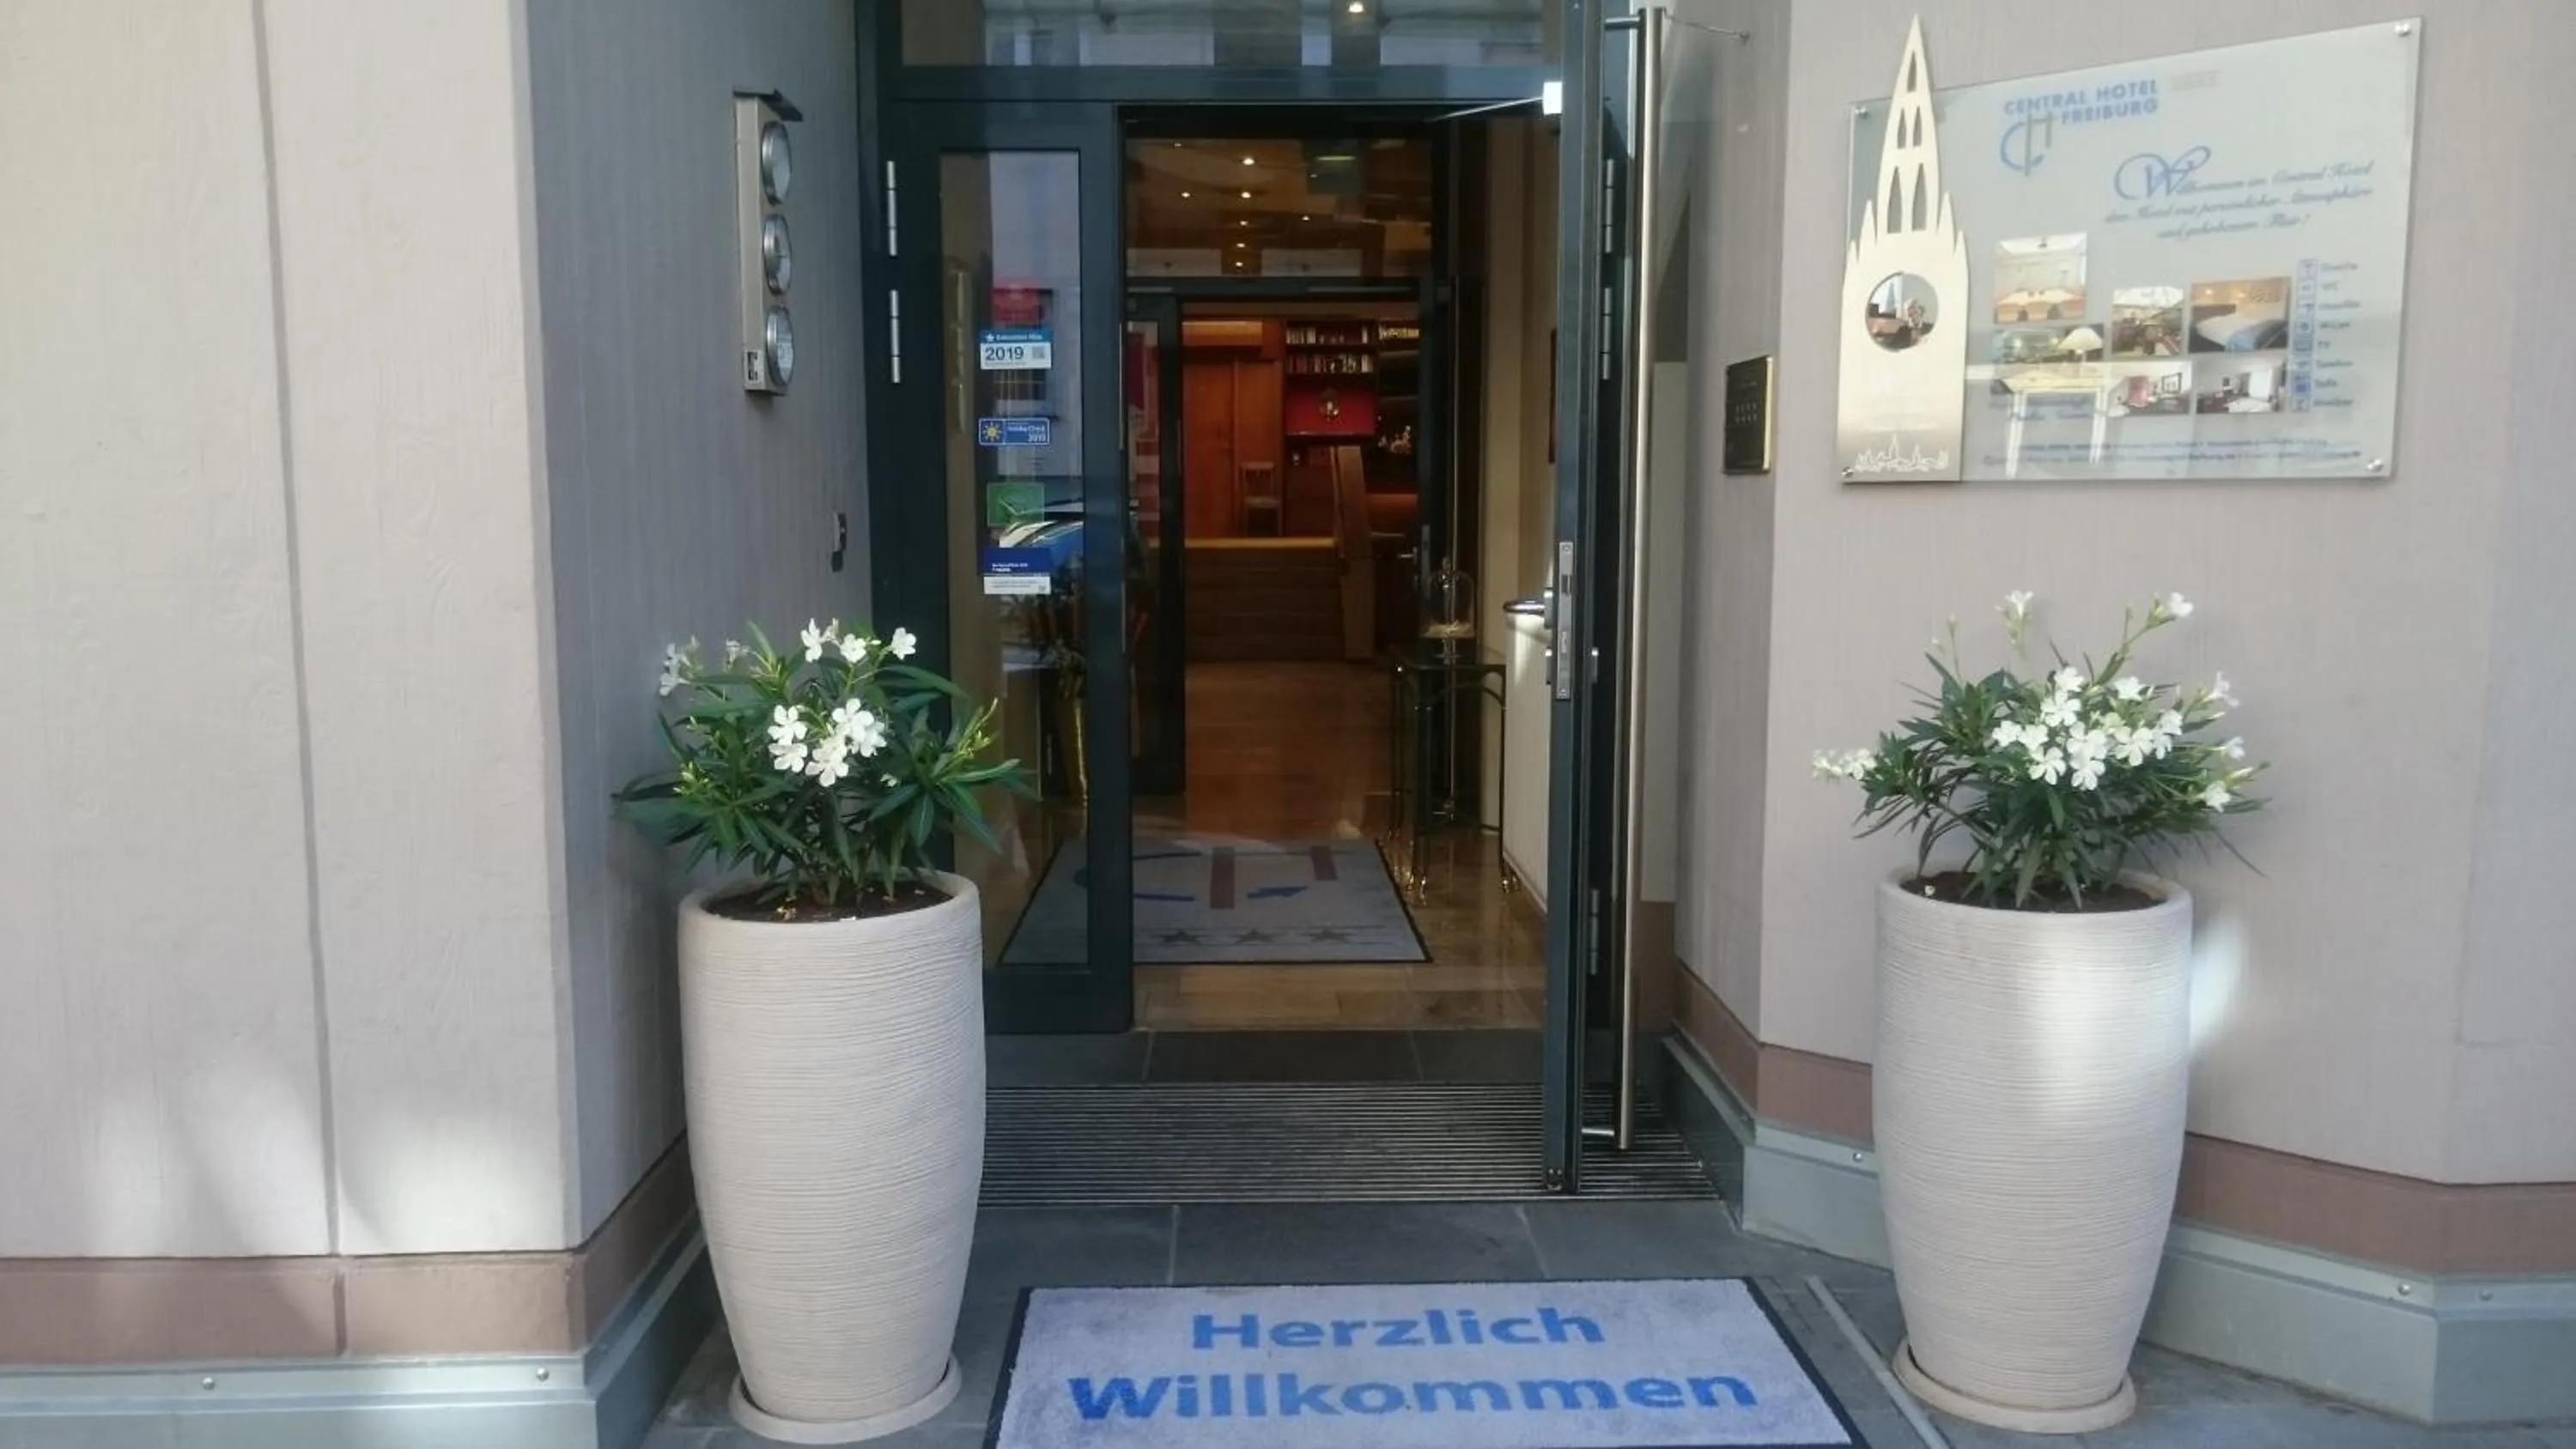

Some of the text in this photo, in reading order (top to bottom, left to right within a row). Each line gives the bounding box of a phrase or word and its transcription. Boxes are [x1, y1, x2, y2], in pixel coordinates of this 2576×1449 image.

[2003, 90, 2087, 116] CENTRAL
[2096, 79, 2158, 102] HOTEL
[2062, 98, 2159, 124] FREIBURG
[985, 346, 1024, 361] 2019
[1190, 1307, 1606, 1351] Herzlich
[1066, 1371, 1759, 1421] Willkommen
